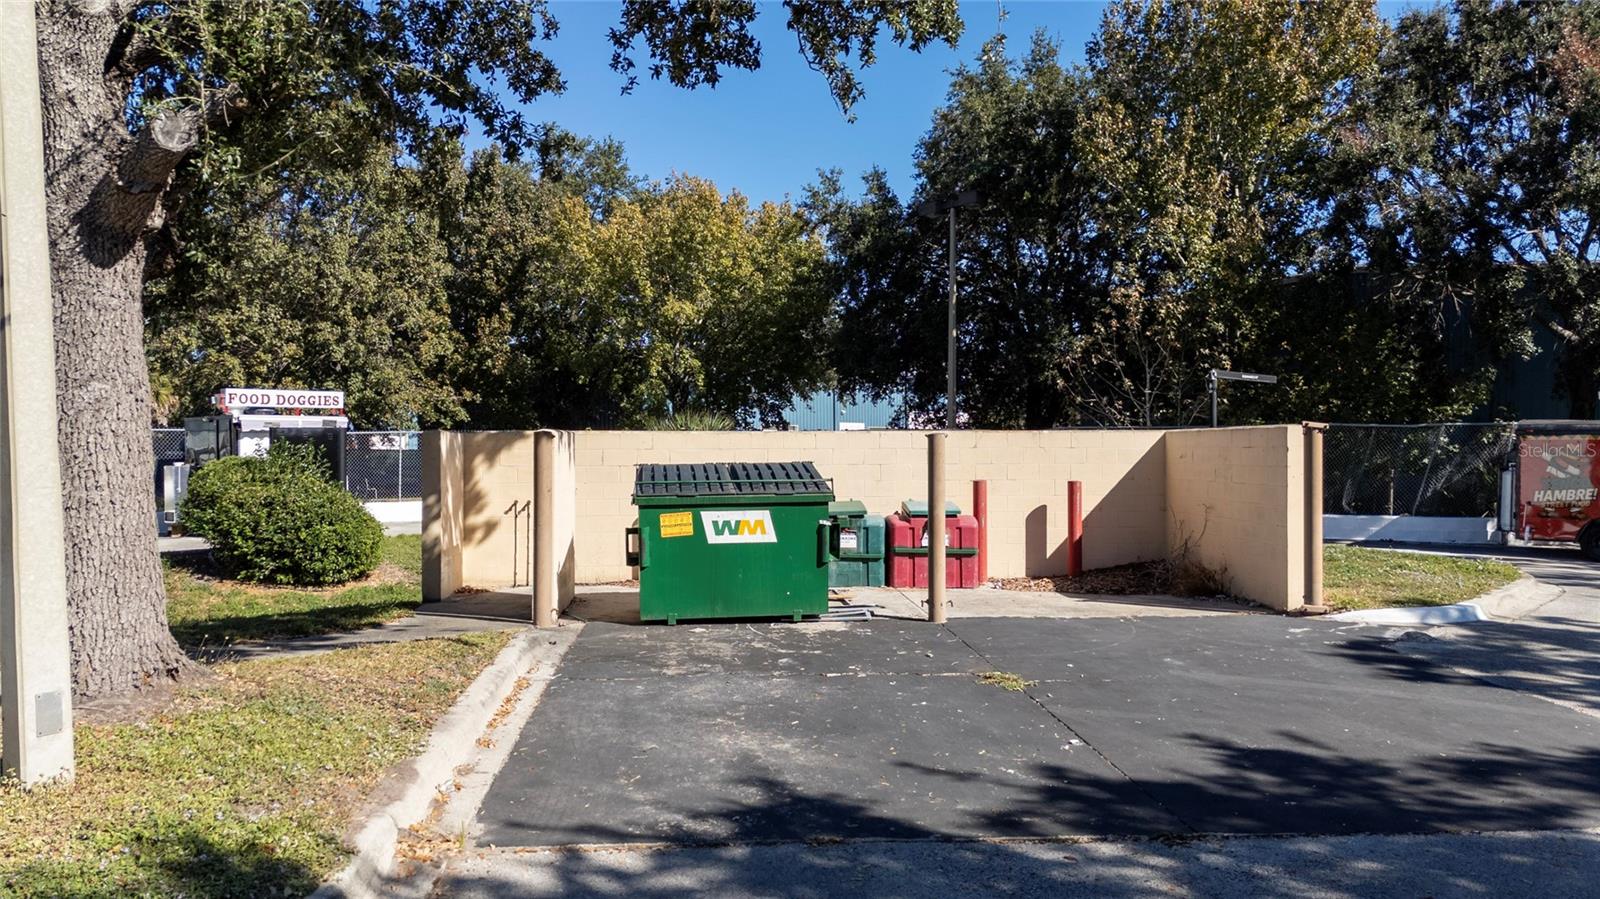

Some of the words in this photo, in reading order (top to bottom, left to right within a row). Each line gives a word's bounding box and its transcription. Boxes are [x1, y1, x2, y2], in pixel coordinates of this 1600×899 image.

[228, 393, 271, 405] FOOD
[276, 394, 340, 406] DOGGIES
[1533, 487, 1598, 502] HAMBRE!
[711, 519, 767, 536] WM
